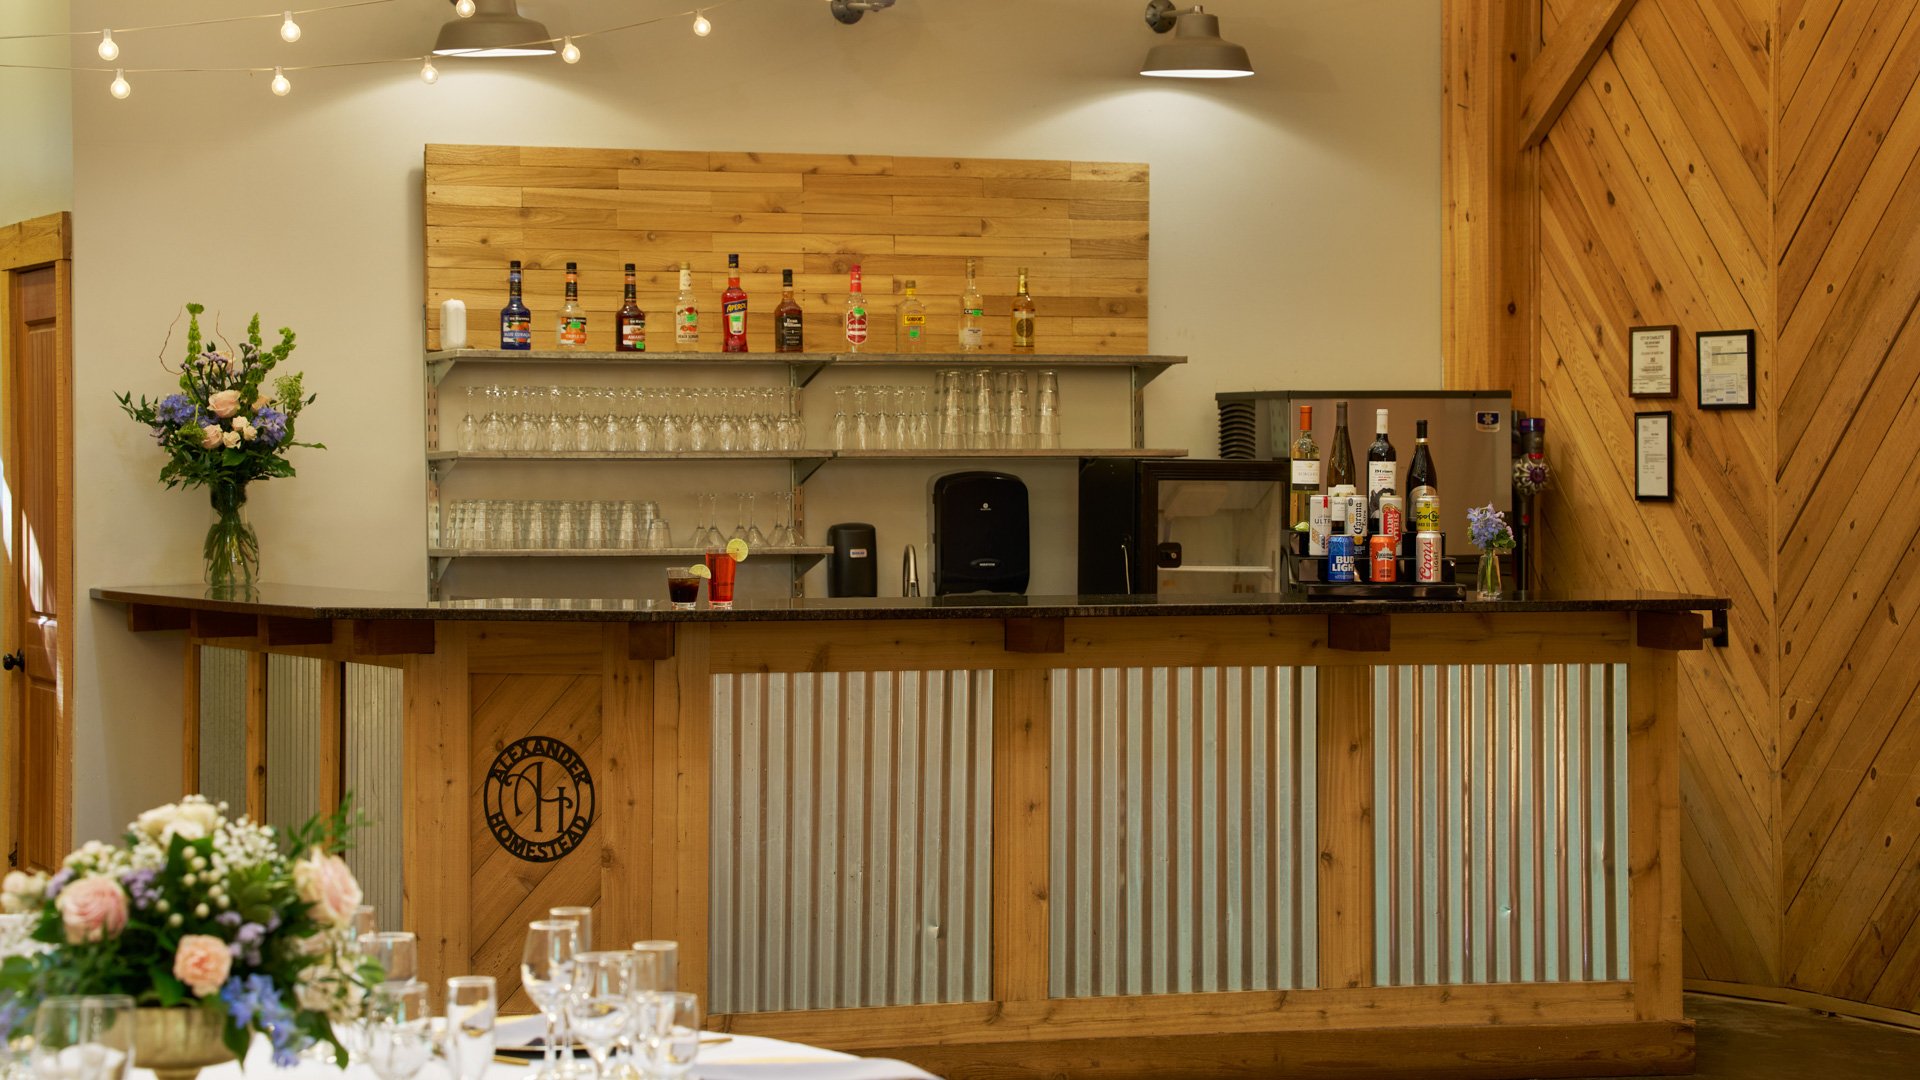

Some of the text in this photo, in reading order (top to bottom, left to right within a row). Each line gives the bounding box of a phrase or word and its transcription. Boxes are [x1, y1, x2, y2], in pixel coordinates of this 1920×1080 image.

[726, 303, 746, 313] APEROL
[1353, 502, 1363, 535] Corona
[1331, 563, 1355, 572] LIGH
[1335, 555, 1355, 564] BUD
[1419, 541, 1433, 580] Coors
[489, 738, 593, 786] ALEXANDER
[487, 812, 590, 860] HOMESTEAD
